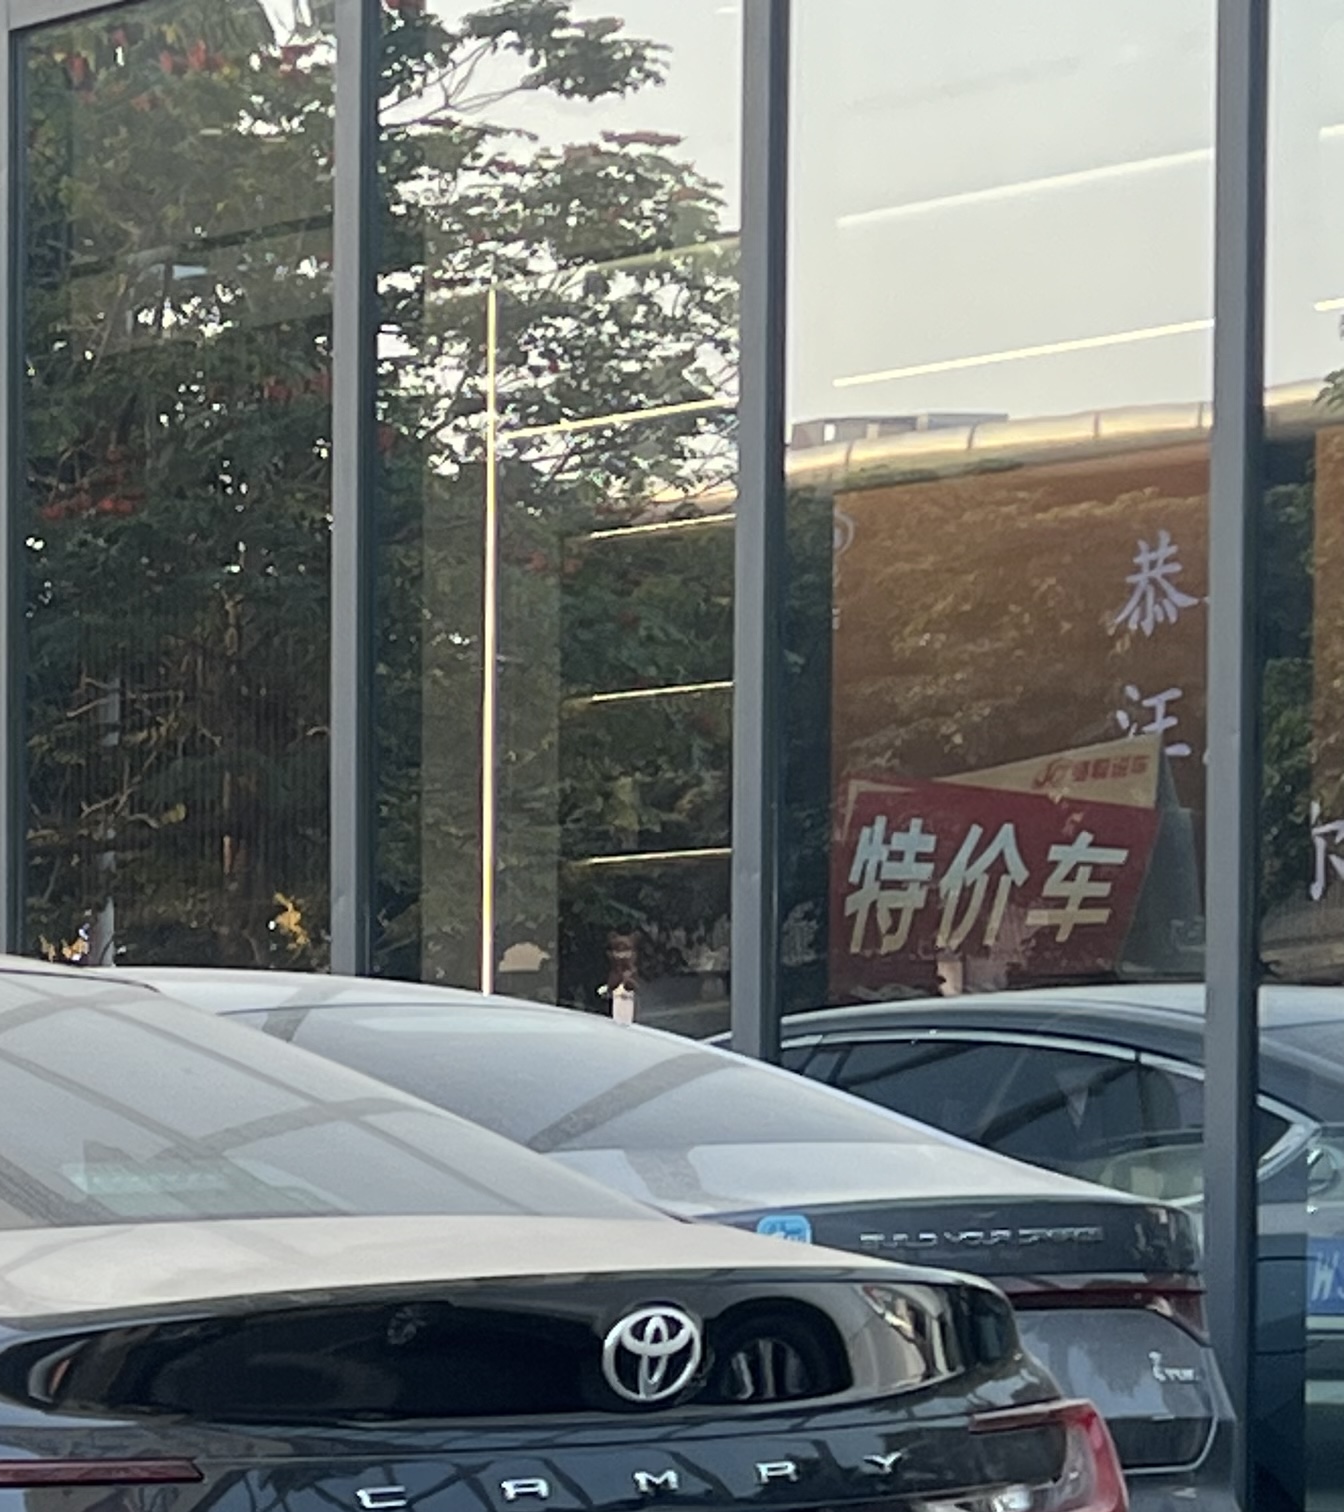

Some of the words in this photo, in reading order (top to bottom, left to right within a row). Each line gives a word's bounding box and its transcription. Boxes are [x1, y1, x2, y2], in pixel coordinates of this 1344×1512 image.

[844, 813, 1129, 957] 特价车
[355, 1449, 906, 1512] CAMRY
